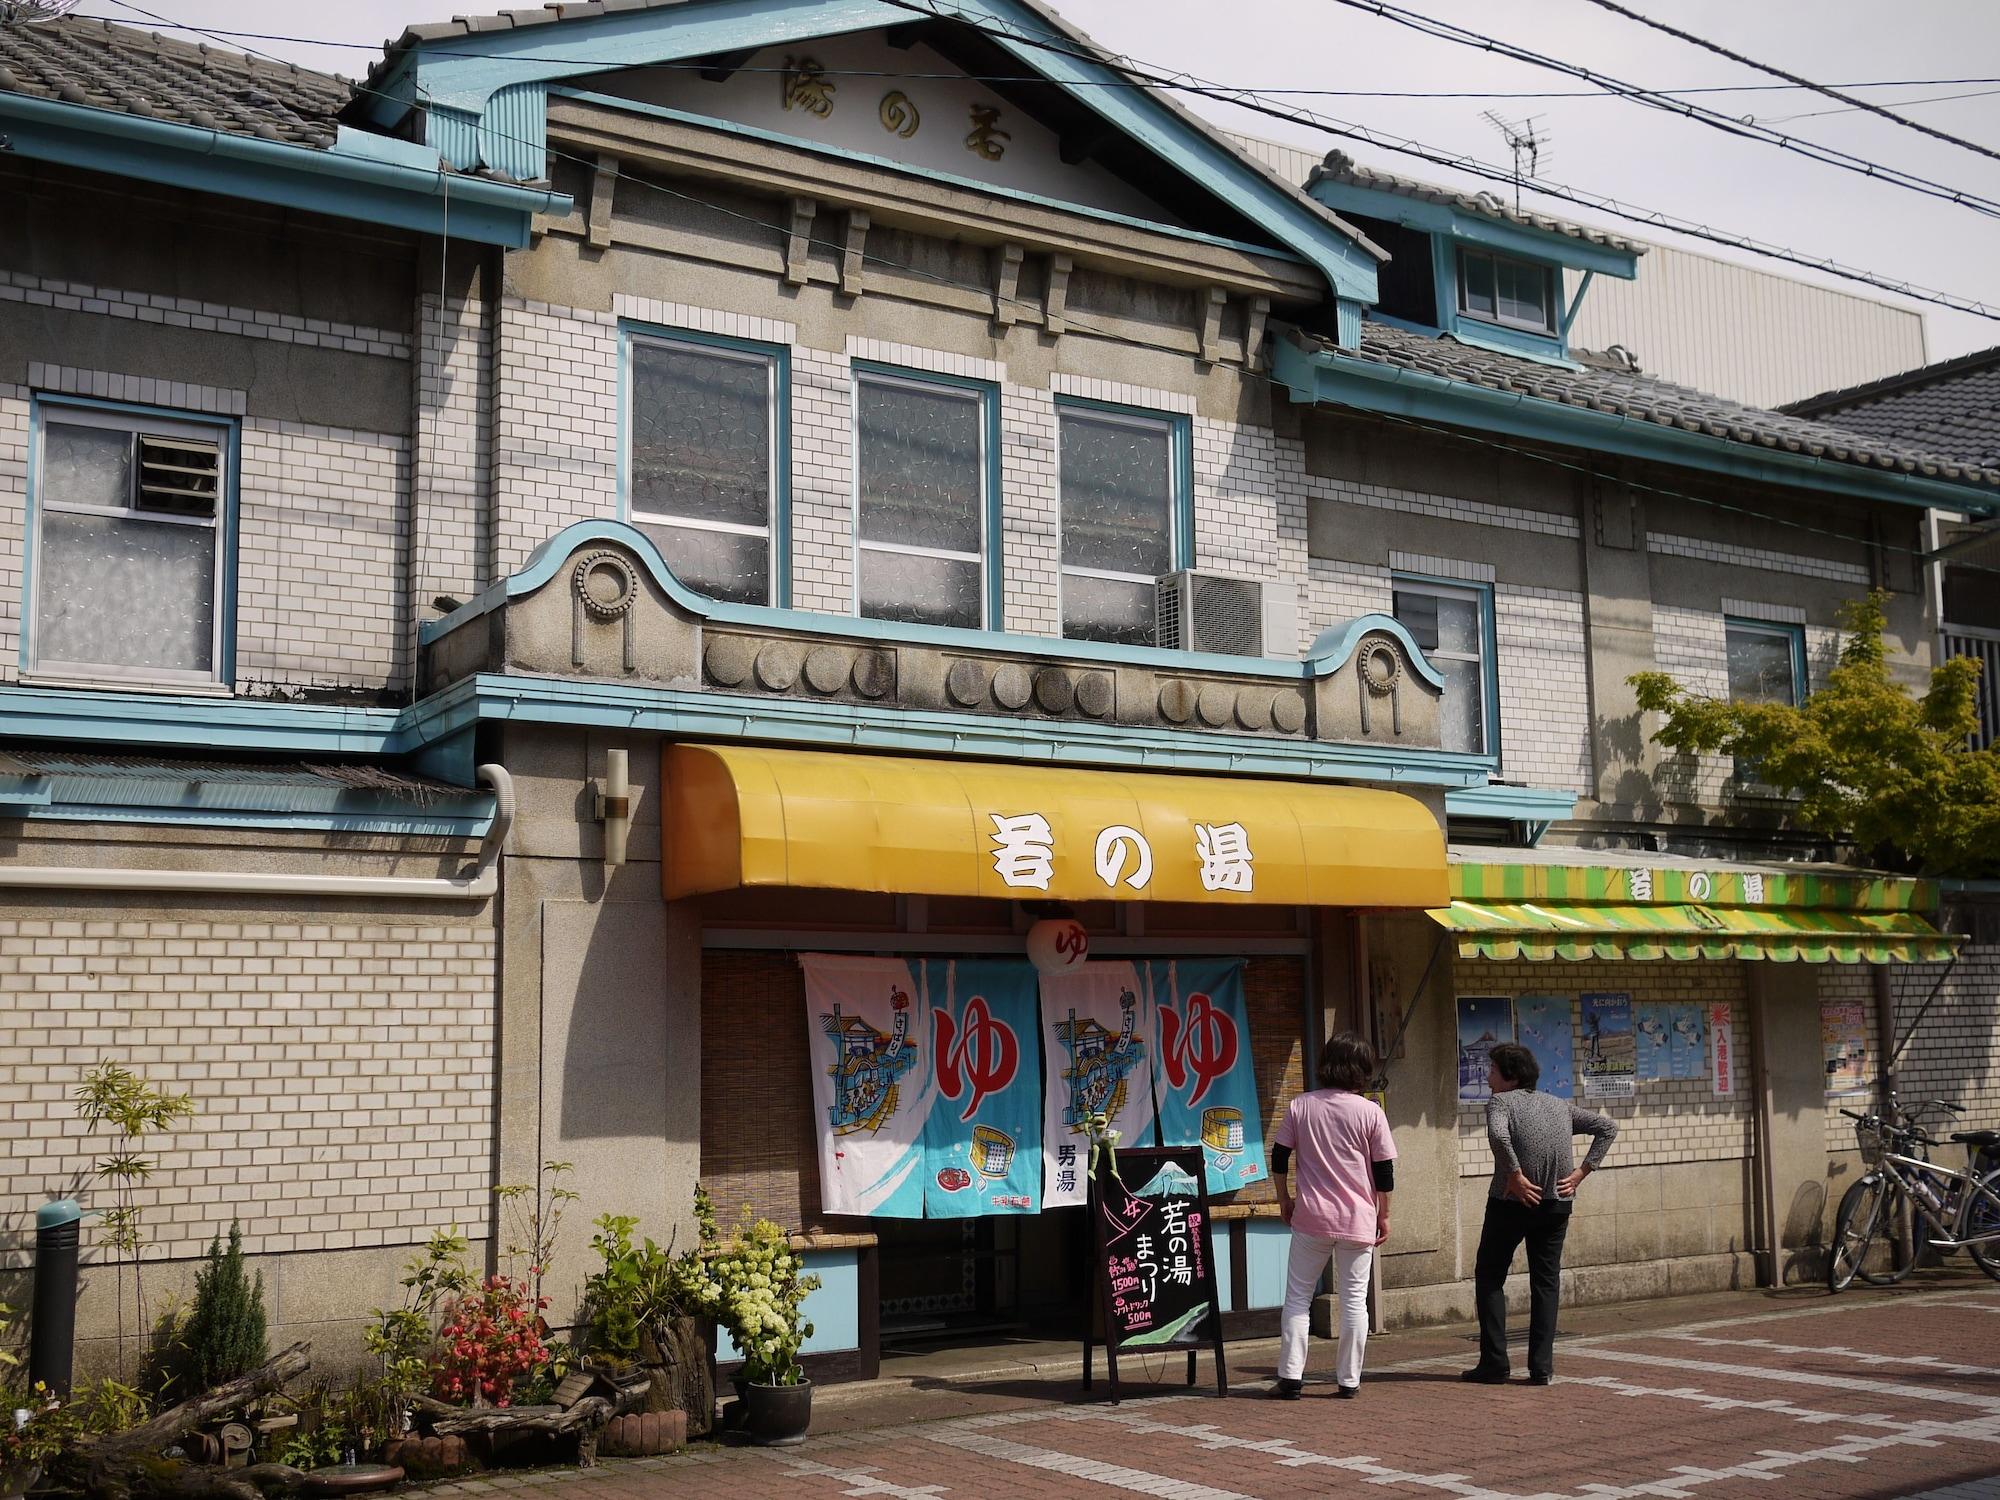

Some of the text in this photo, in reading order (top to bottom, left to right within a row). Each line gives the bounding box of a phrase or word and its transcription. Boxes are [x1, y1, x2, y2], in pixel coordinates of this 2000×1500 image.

[988, 812, 1254, 893] 若の湯
[1629, 868, 1764, 904] 若の湯
[1055, 924, 1088, 965] ゆ
[934, 997, 1018, 1120] ゆ
[1159, 994, 1238, 1107] ゆ
[1056, 1144, 1077, 1192] 男湯
[1160, 1200, 1192, 1286] 若の湯
[1112, 1276, 1140, 1291] 1500円
[1136, 1233, 1159, 1303] まつり
[1113, 1300, 1149, 1316] ソフトドリンク
[1128, 1311, 1152, 1324] 500円
